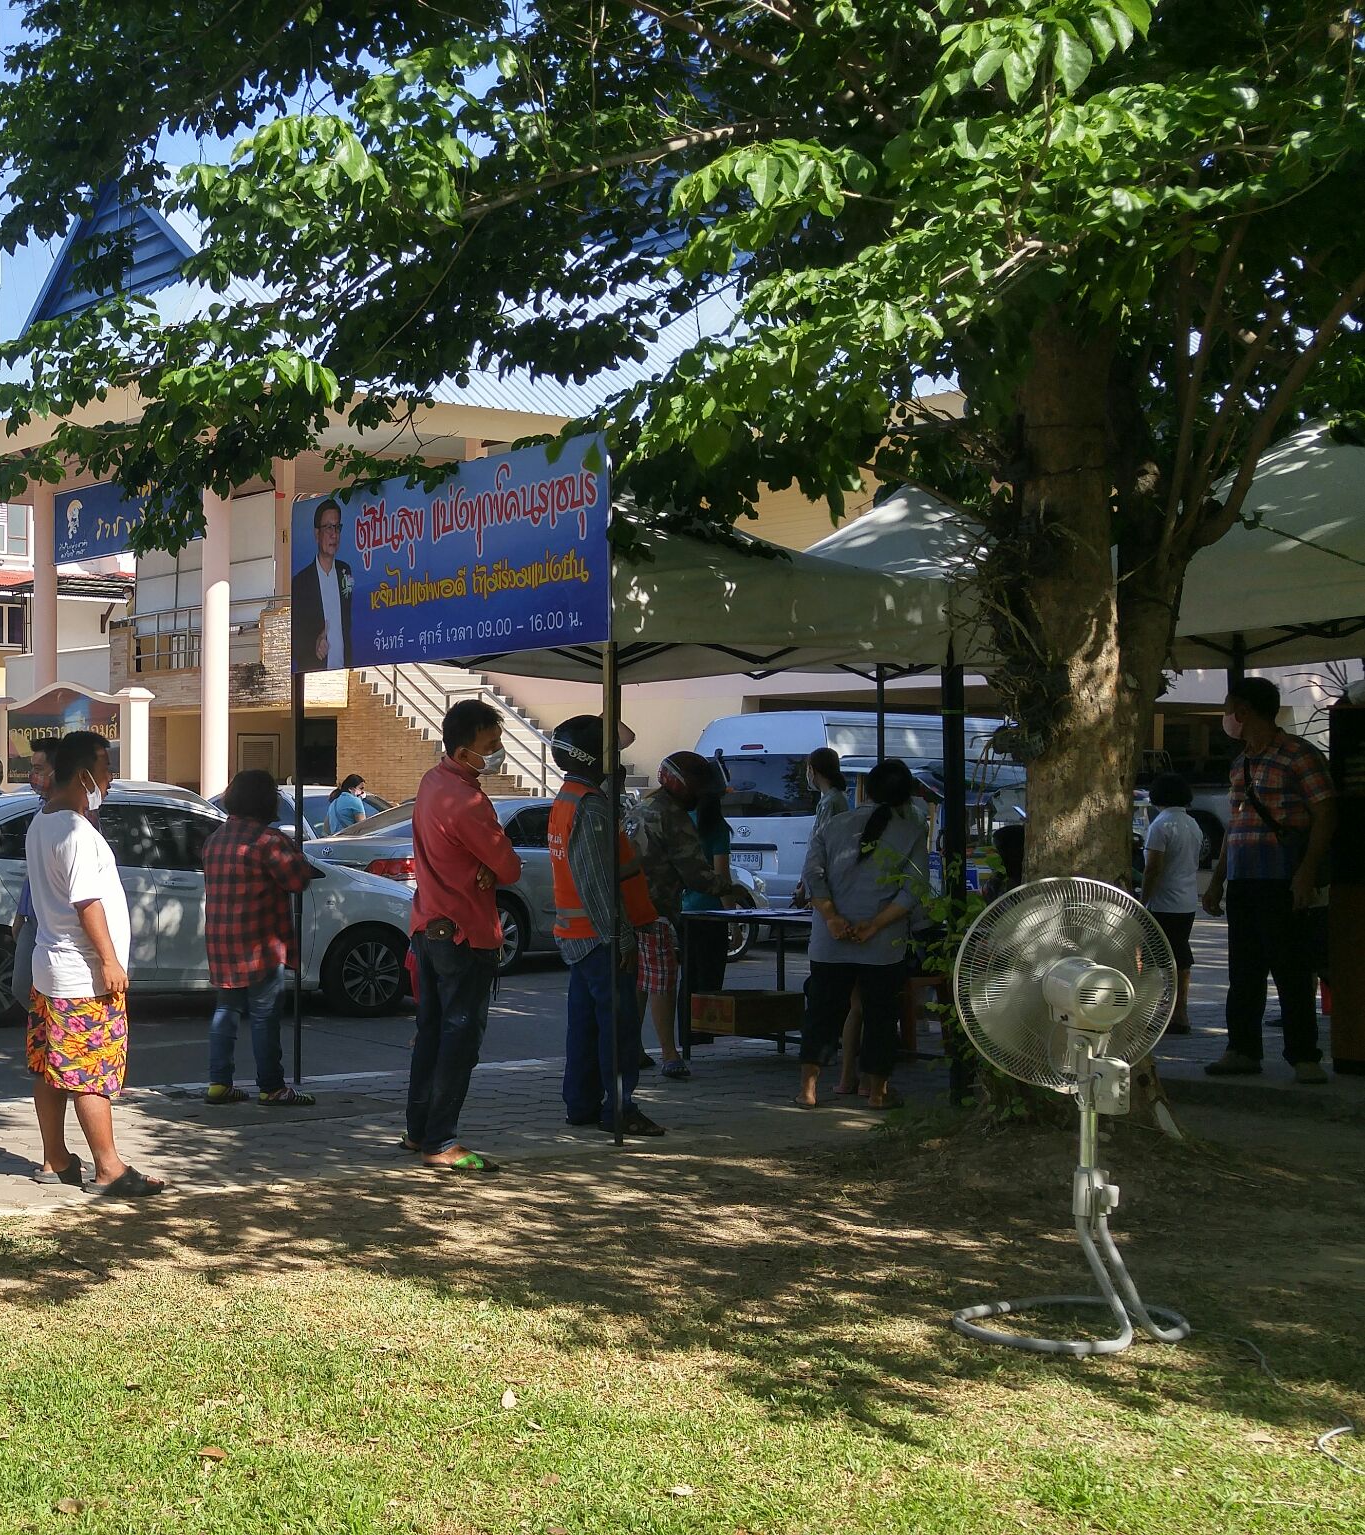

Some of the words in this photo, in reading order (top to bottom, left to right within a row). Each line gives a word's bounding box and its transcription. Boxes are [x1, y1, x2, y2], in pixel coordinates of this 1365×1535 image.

[355, 498, 425, 571] ตู้ปันสุข
[370, 562, 468, 610] หยิบไปแต่พอดี
[373, 626, 405, 651] จันทร์
[418, 621, 443, 654] ศุกร์
[446, 624, 473, 642] เวลา
[476, 617, 512, 639] 09.00
[528, 610, 564, 633] 16.00
[568, 610, 584, 627] น.
[742, 854, 759, 863] 3838
